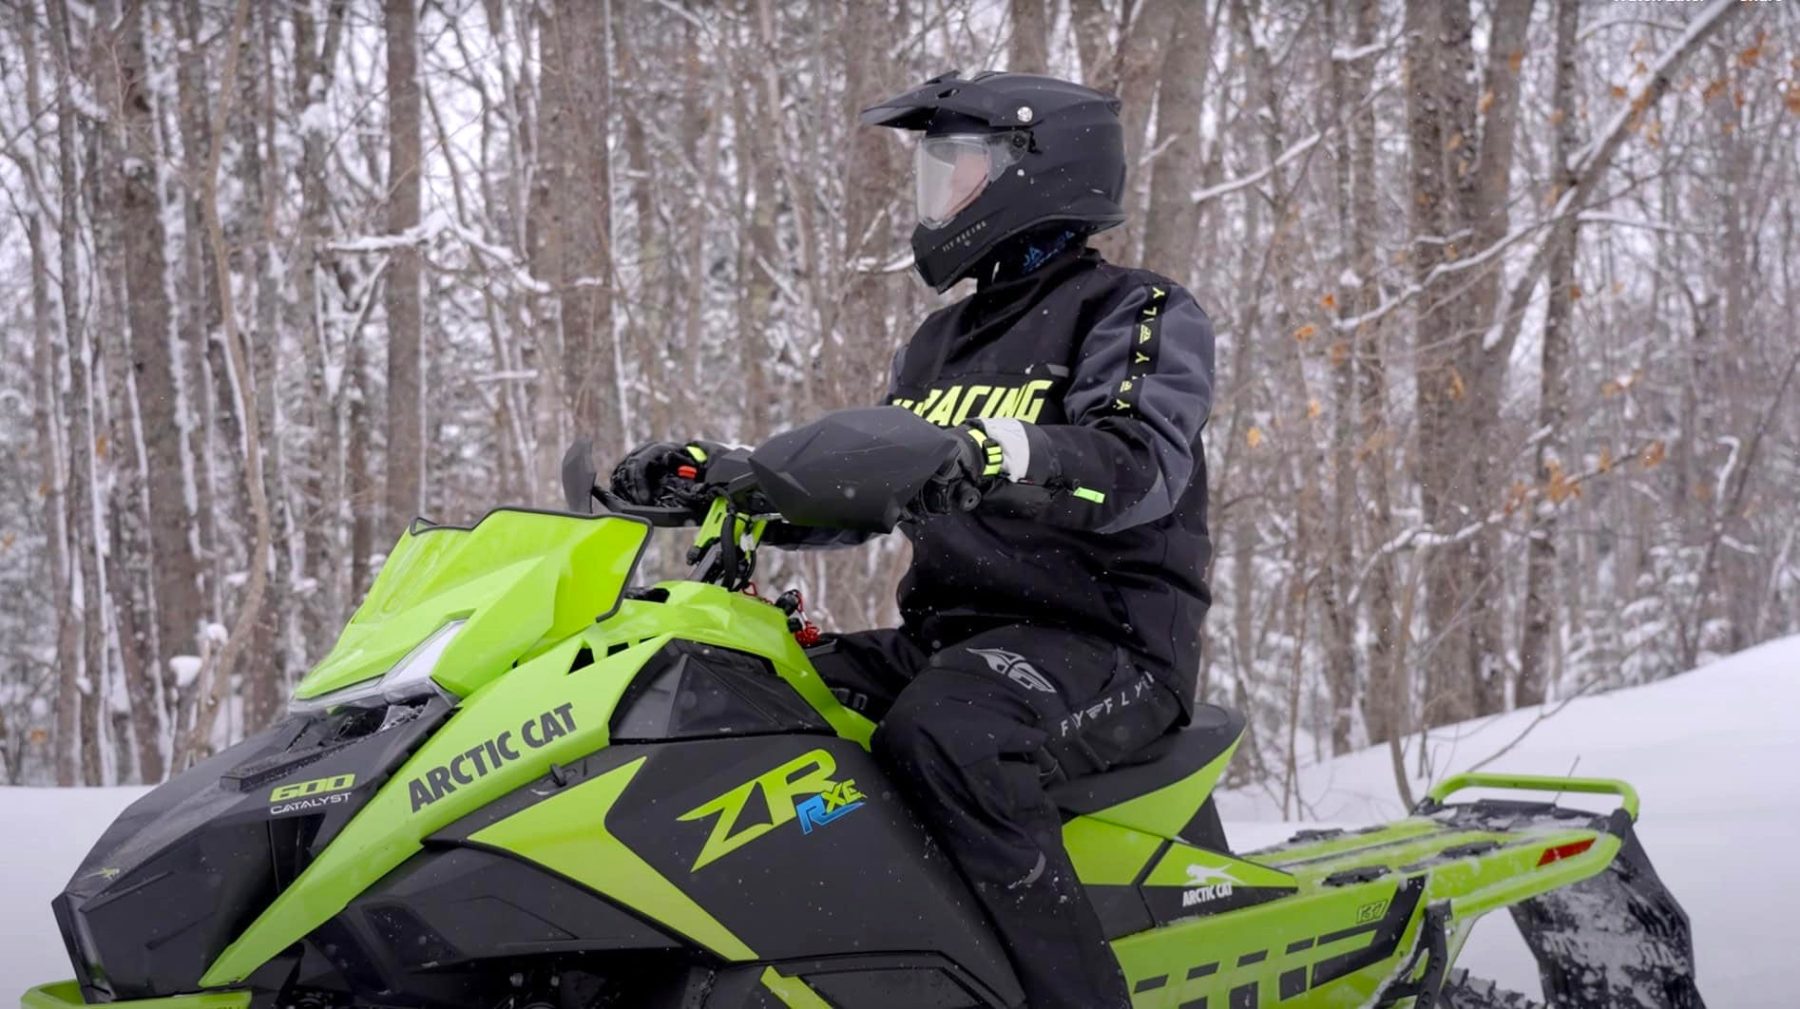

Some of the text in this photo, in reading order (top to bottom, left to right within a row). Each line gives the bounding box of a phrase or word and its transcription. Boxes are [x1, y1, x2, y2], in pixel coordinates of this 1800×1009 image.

[408, 702, 578, 813] ARCTIC CAT
[270, 774, 356, 802] 600
[270, 792, 353, 815] CATALYST
[676, 748, 838, 873] ZR
[1182, 882, 1233, 907] ARCTIC CAT
